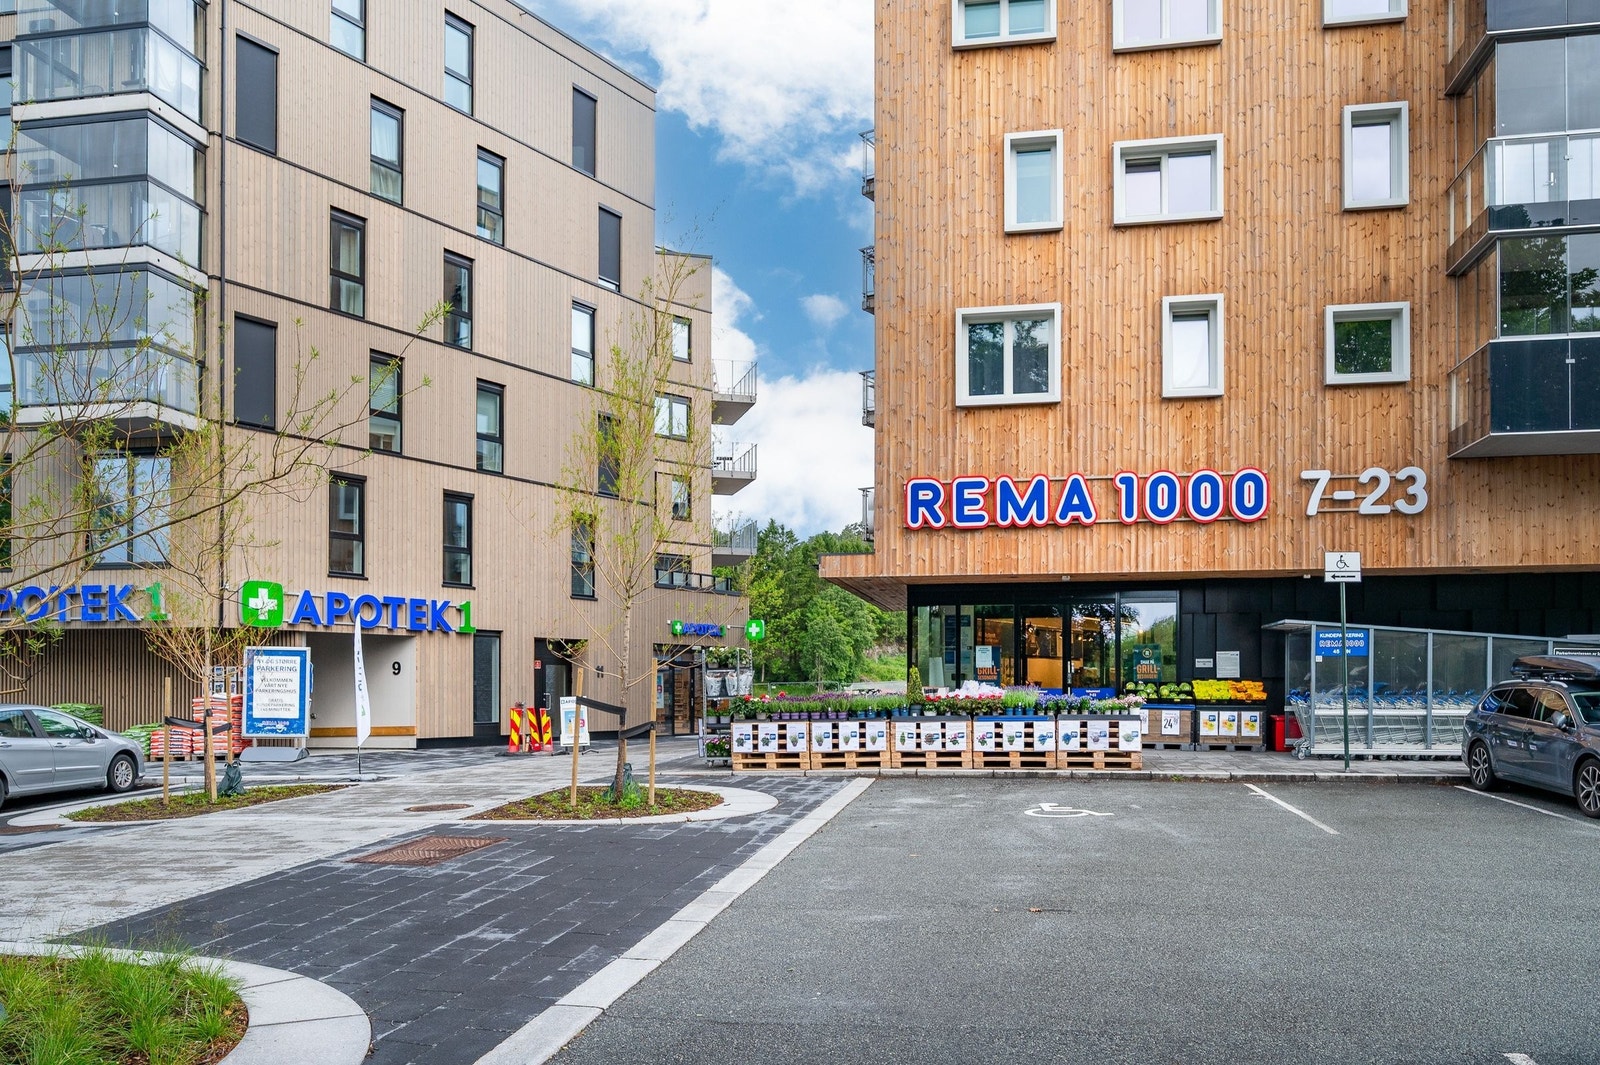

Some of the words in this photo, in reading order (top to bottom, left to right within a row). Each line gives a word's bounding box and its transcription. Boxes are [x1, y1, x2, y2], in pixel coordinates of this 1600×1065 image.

[905, 473, 1097, 530] REMA
[1112, 466, 1269, 526] 1000
[1300, 466, 1428, 516] 7-23
[288, 589, 453, 632] APOTEK
[456, 601, 476, 634] 1
[392, 661, 401, 676] 9
